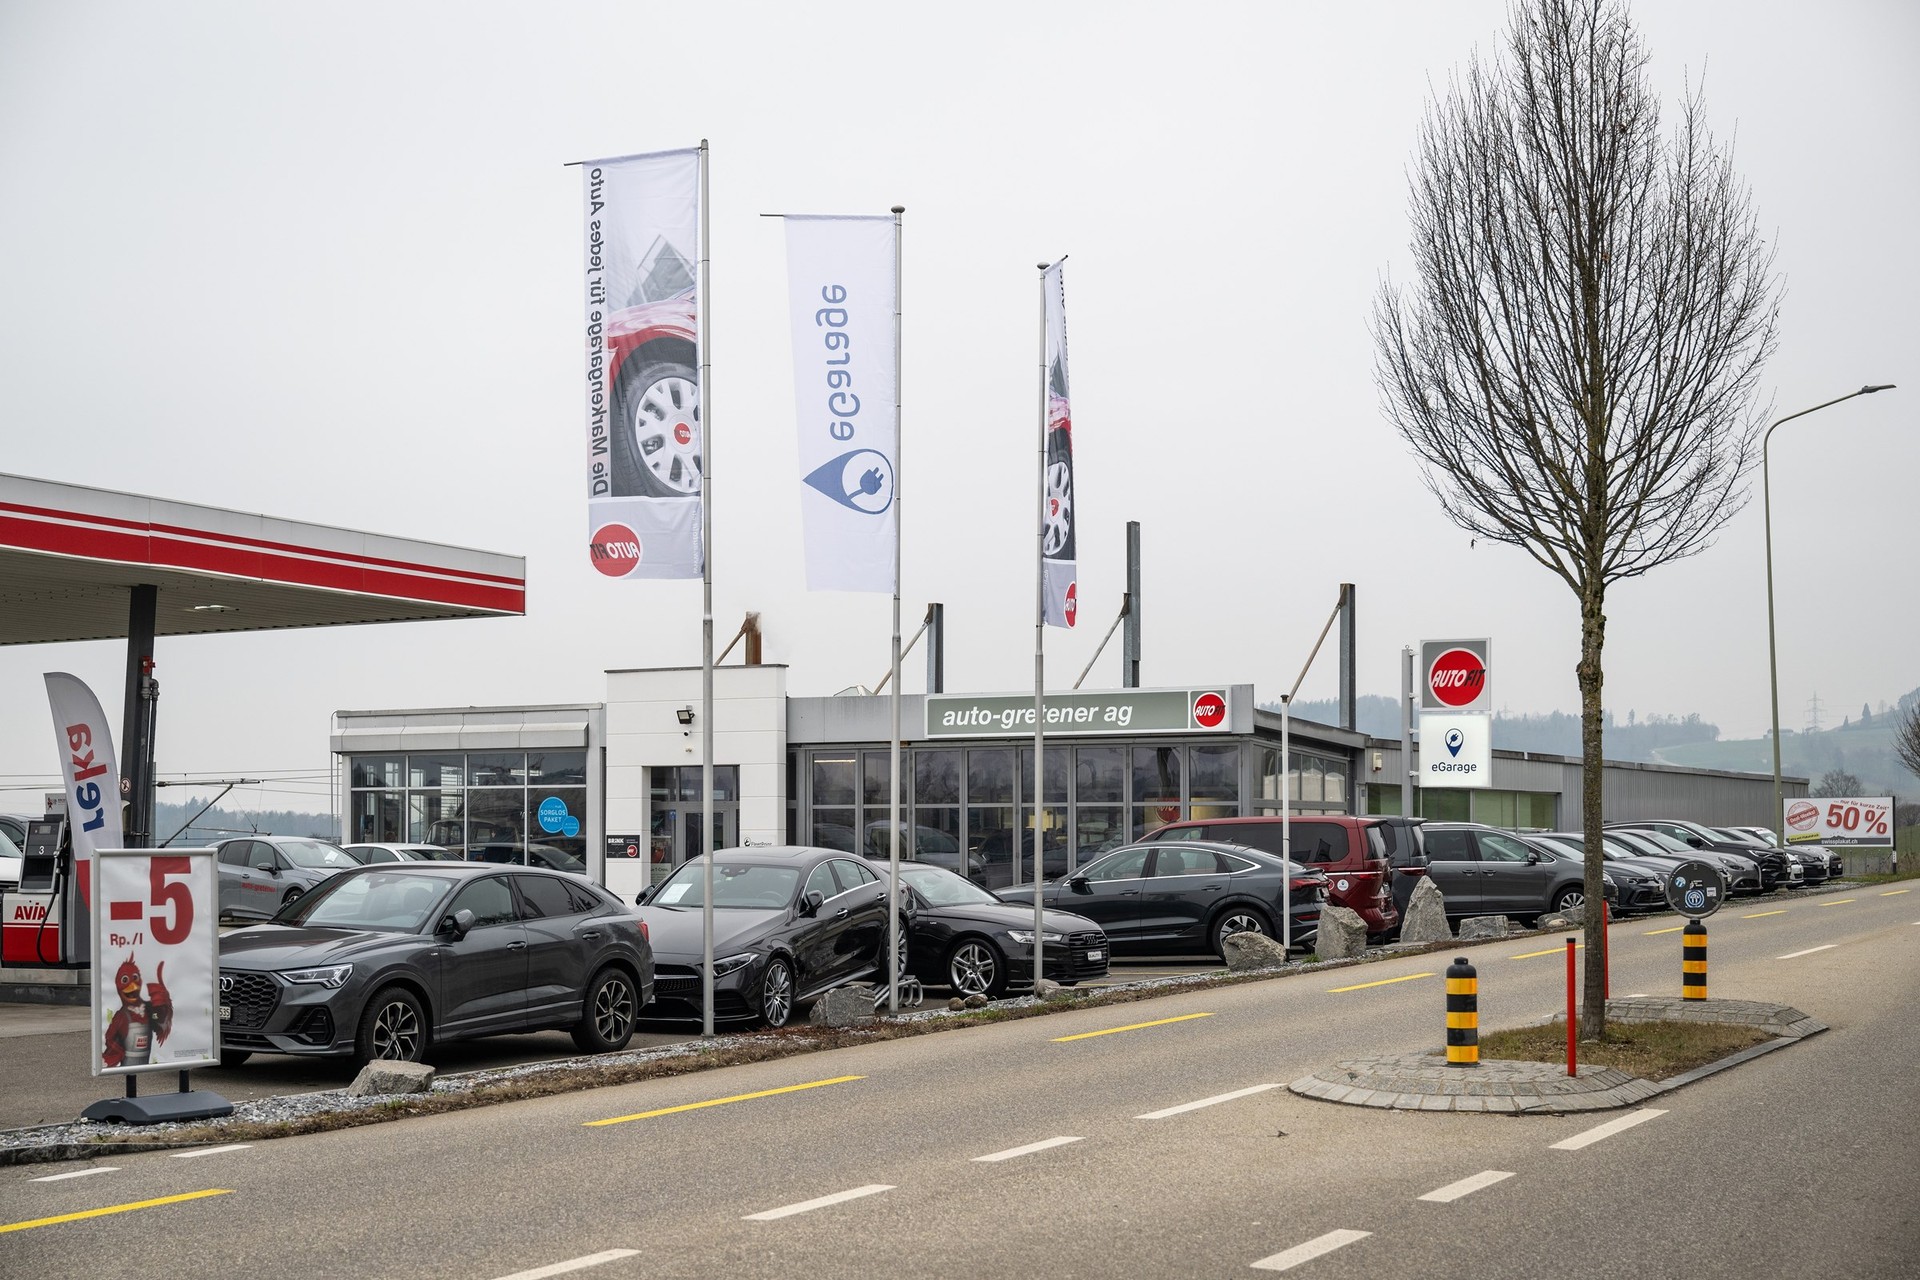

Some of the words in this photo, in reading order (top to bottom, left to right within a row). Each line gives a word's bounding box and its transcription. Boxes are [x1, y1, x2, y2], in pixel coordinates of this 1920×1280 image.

[1431, 669, 1487, 687] AUTOFIT
[1103, 705, 1133, 726] ag
[1431, 762, 1477, 774] eGarage
[540, 808, 567, 817] SORGLOS
[38, 845, 45, 855] 3
